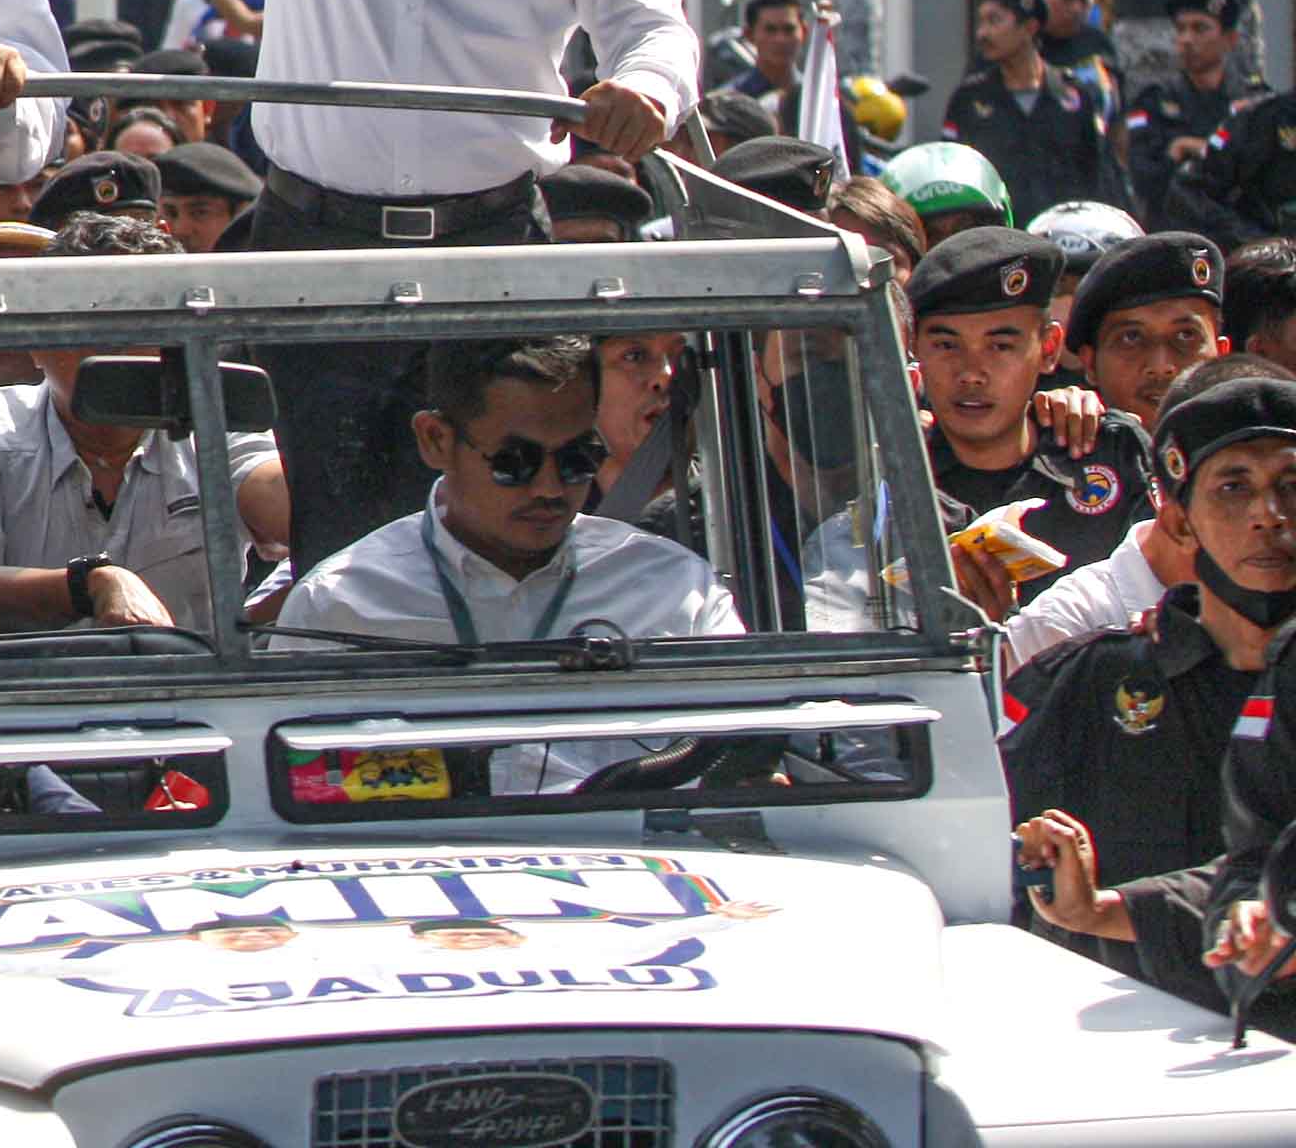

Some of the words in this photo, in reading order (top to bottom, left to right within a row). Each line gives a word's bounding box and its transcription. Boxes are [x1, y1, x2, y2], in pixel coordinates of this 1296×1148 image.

[1, 874, 176, 900] ANIES
[248, 854, 626, 877] MUHAIMIN
[146, 976, 381, 1013] AJA
[396, 969, 674, 994] DULU
